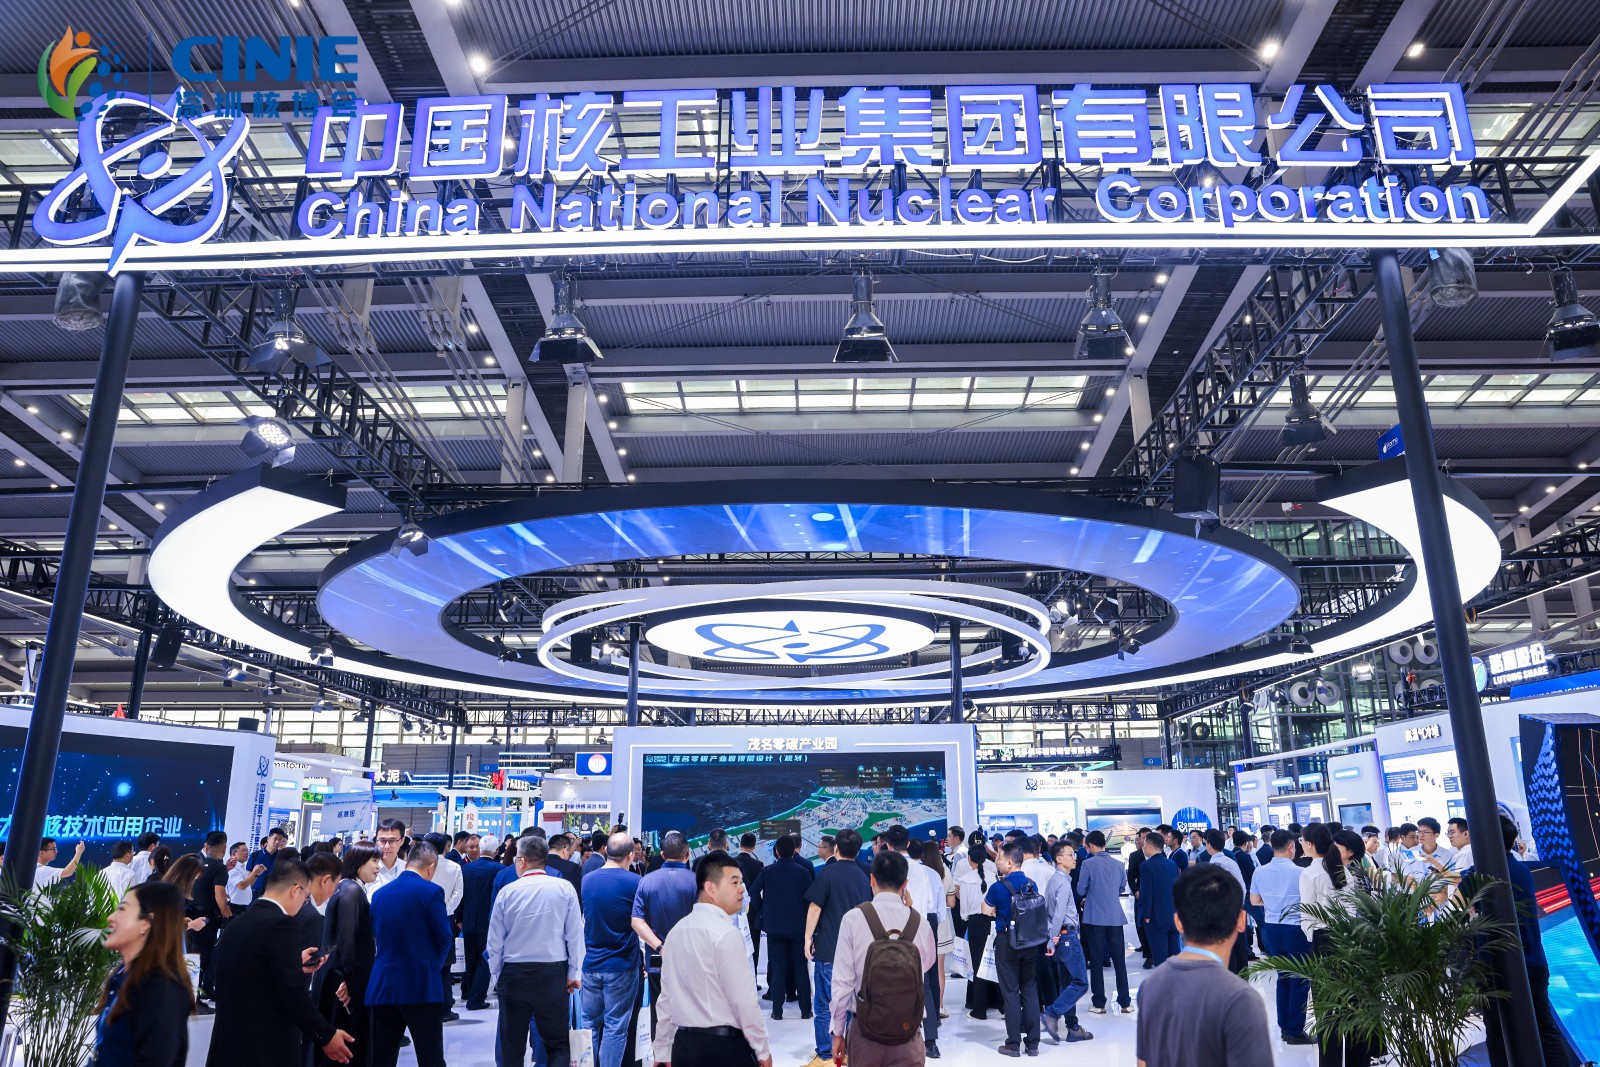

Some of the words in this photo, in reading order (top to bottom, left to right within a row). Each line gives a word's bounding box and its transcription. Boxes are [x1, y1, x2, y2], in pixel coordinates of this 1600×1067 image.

[305, 83, 1476, 184] 中国核工业集团有限公司
[297, 189, 480, 240] China
[510, 178, 783, 234] National
[807, 177, 1057, 226] Nuclear
[1096, 174, 1491, 228] Corporation
[1493, 671, 1523, 685] LUTONG
[1523, 665, 1549, 679] SHARE
[748, 737, 838, 751] 茂名零碳产业园
